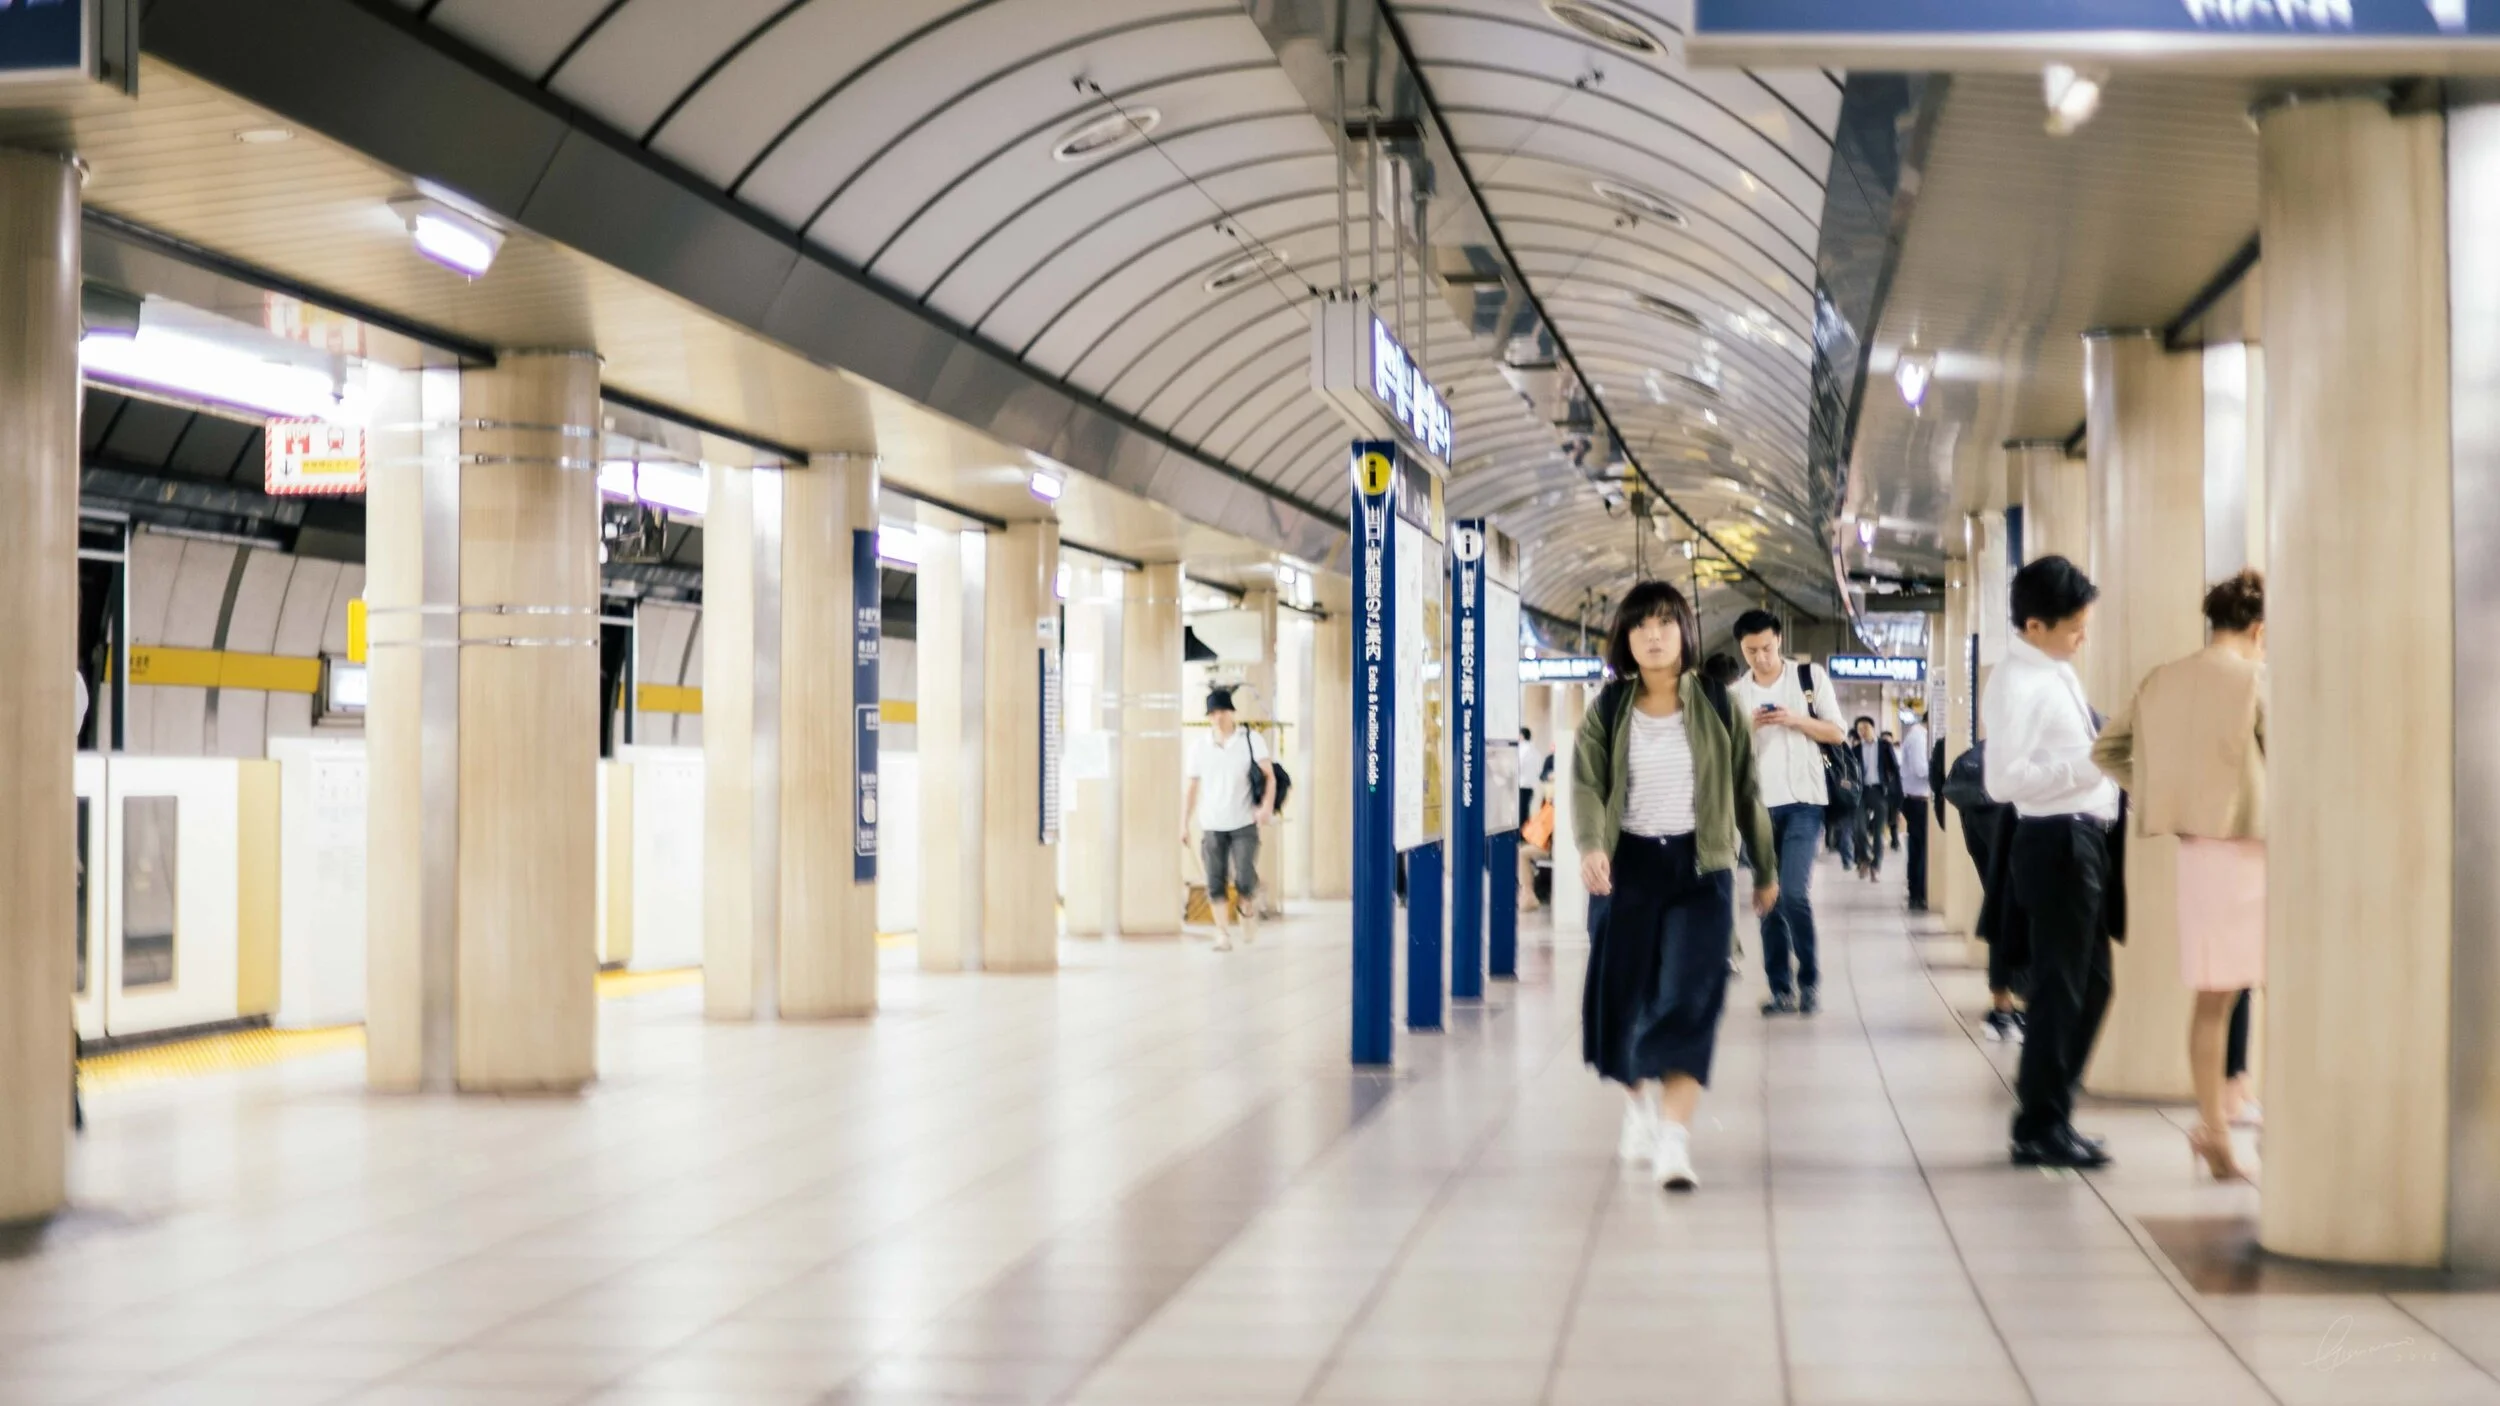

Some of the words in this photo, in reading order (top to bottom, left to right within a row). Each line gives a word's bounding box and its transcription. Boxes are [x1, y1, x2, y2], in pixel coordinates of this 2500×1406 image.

[1368, 665, 1379, 692] Exits
[1368, 693, 1379, 703] &
[1368, 704, 1379, 751] Facilities
[1368, 752, 1379, 785] Guide
[1463, 782, 1472, 807] Guide
